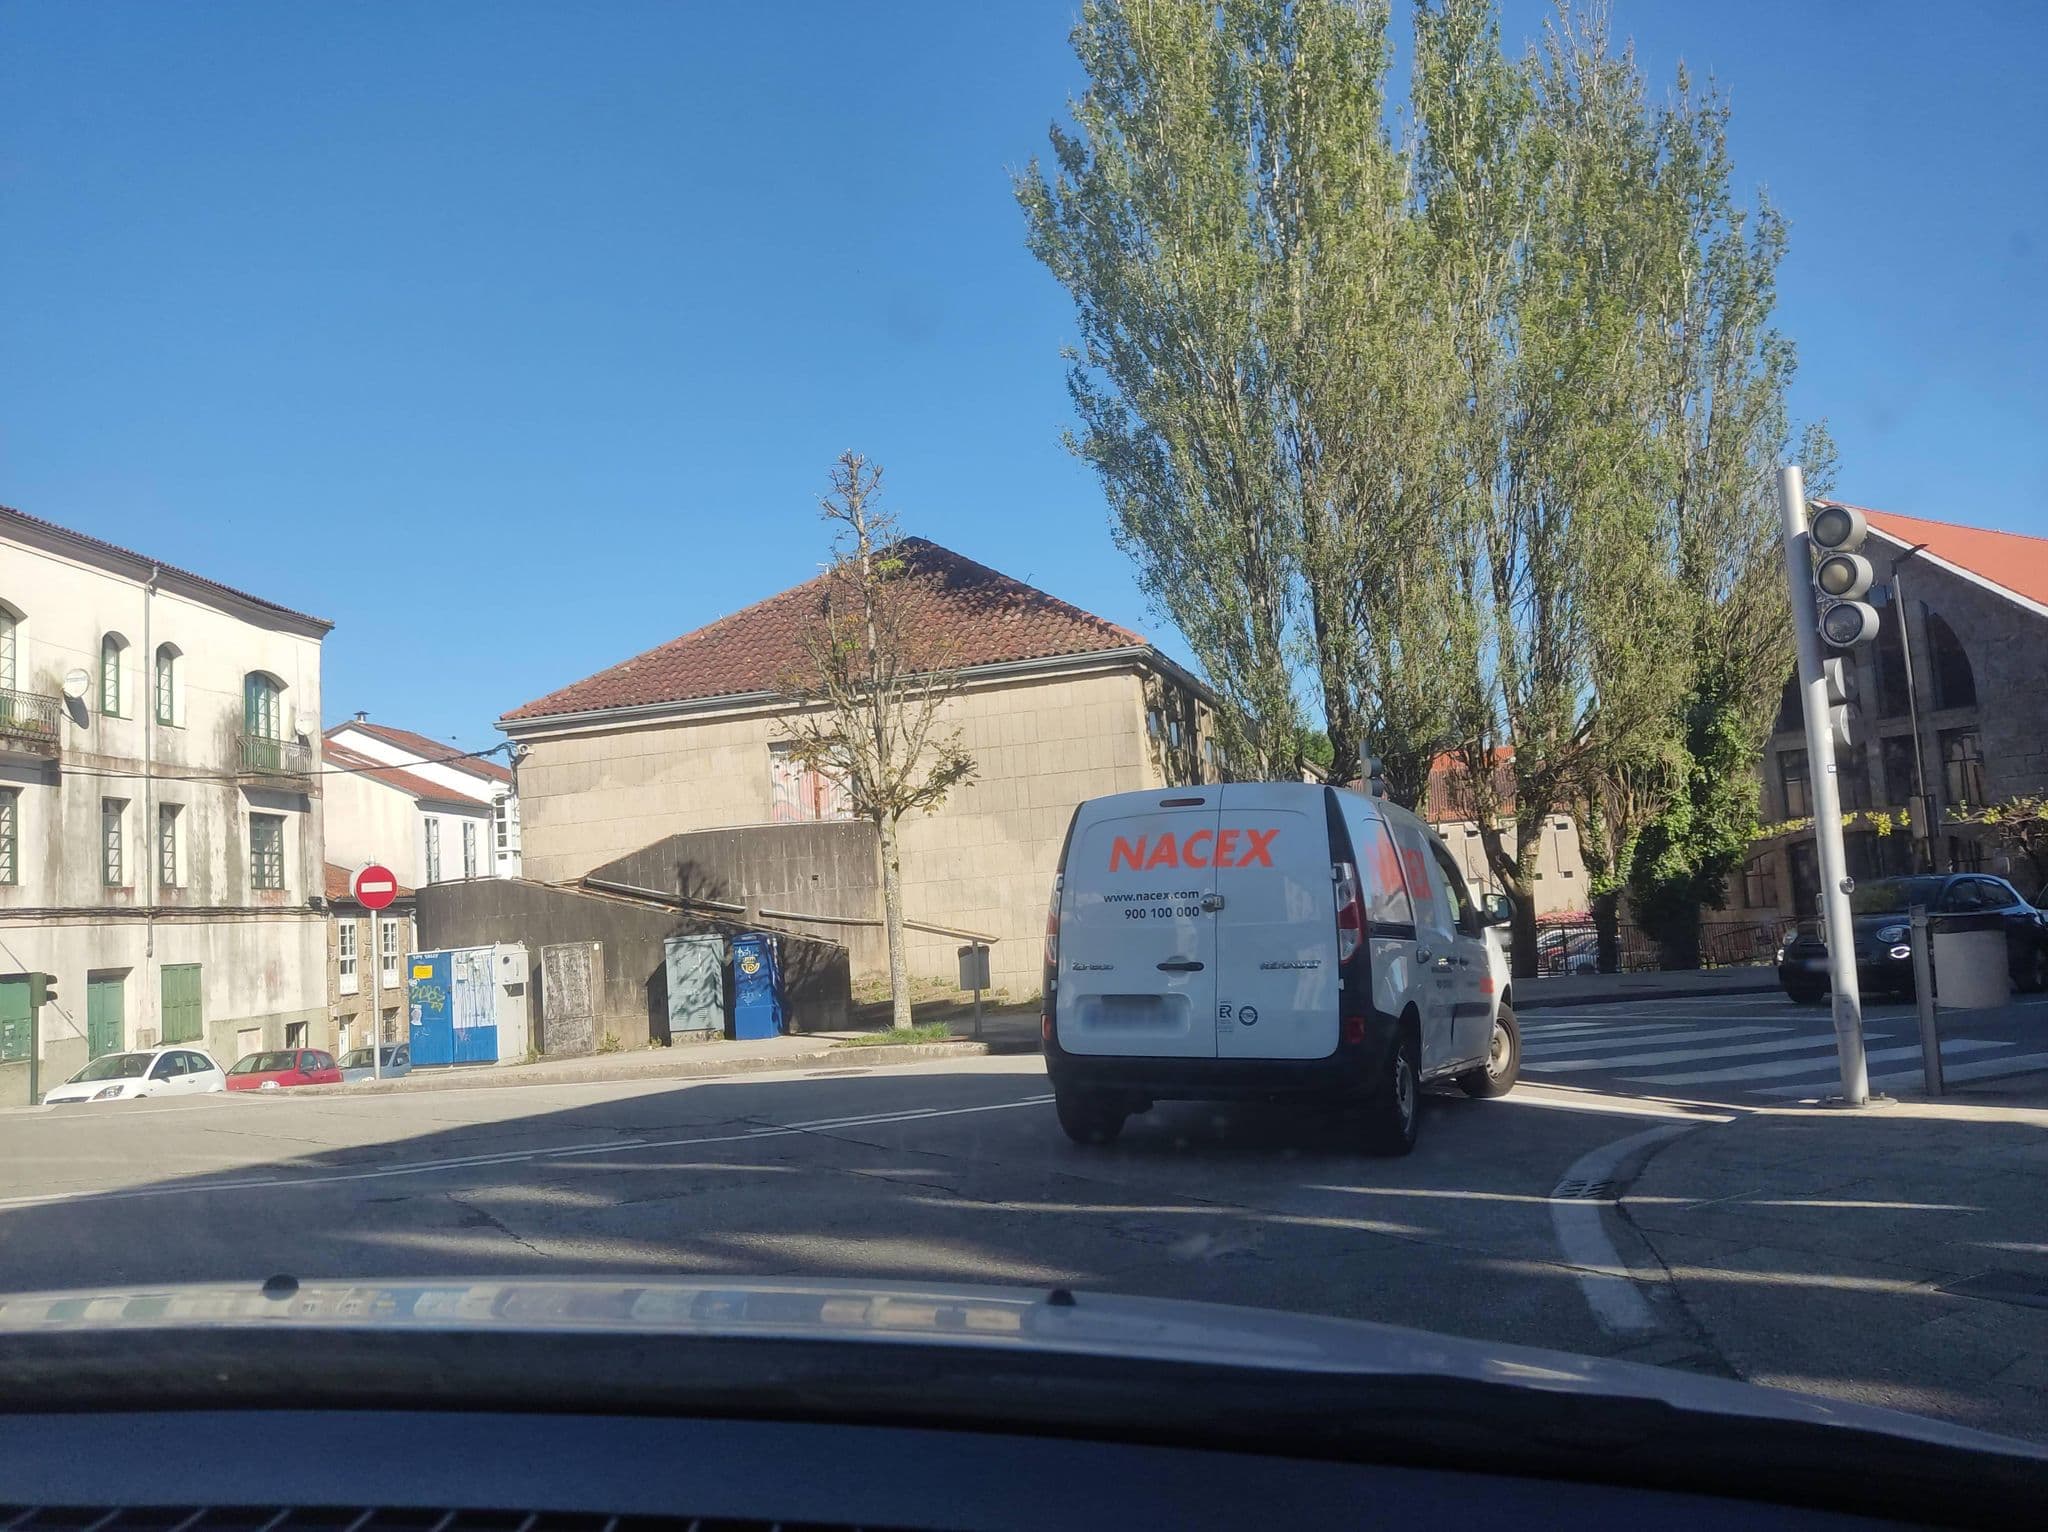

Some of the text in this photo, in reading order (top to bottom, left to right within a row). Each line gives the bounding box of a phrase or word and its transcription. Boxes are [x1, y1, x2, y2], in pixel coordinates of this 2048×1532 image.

[1109, 829, 1280, 872] NACEX
[1103, 891, 1199, 903] www.nacex.com
[1124, 906, 1200, 920] 900 100 000
